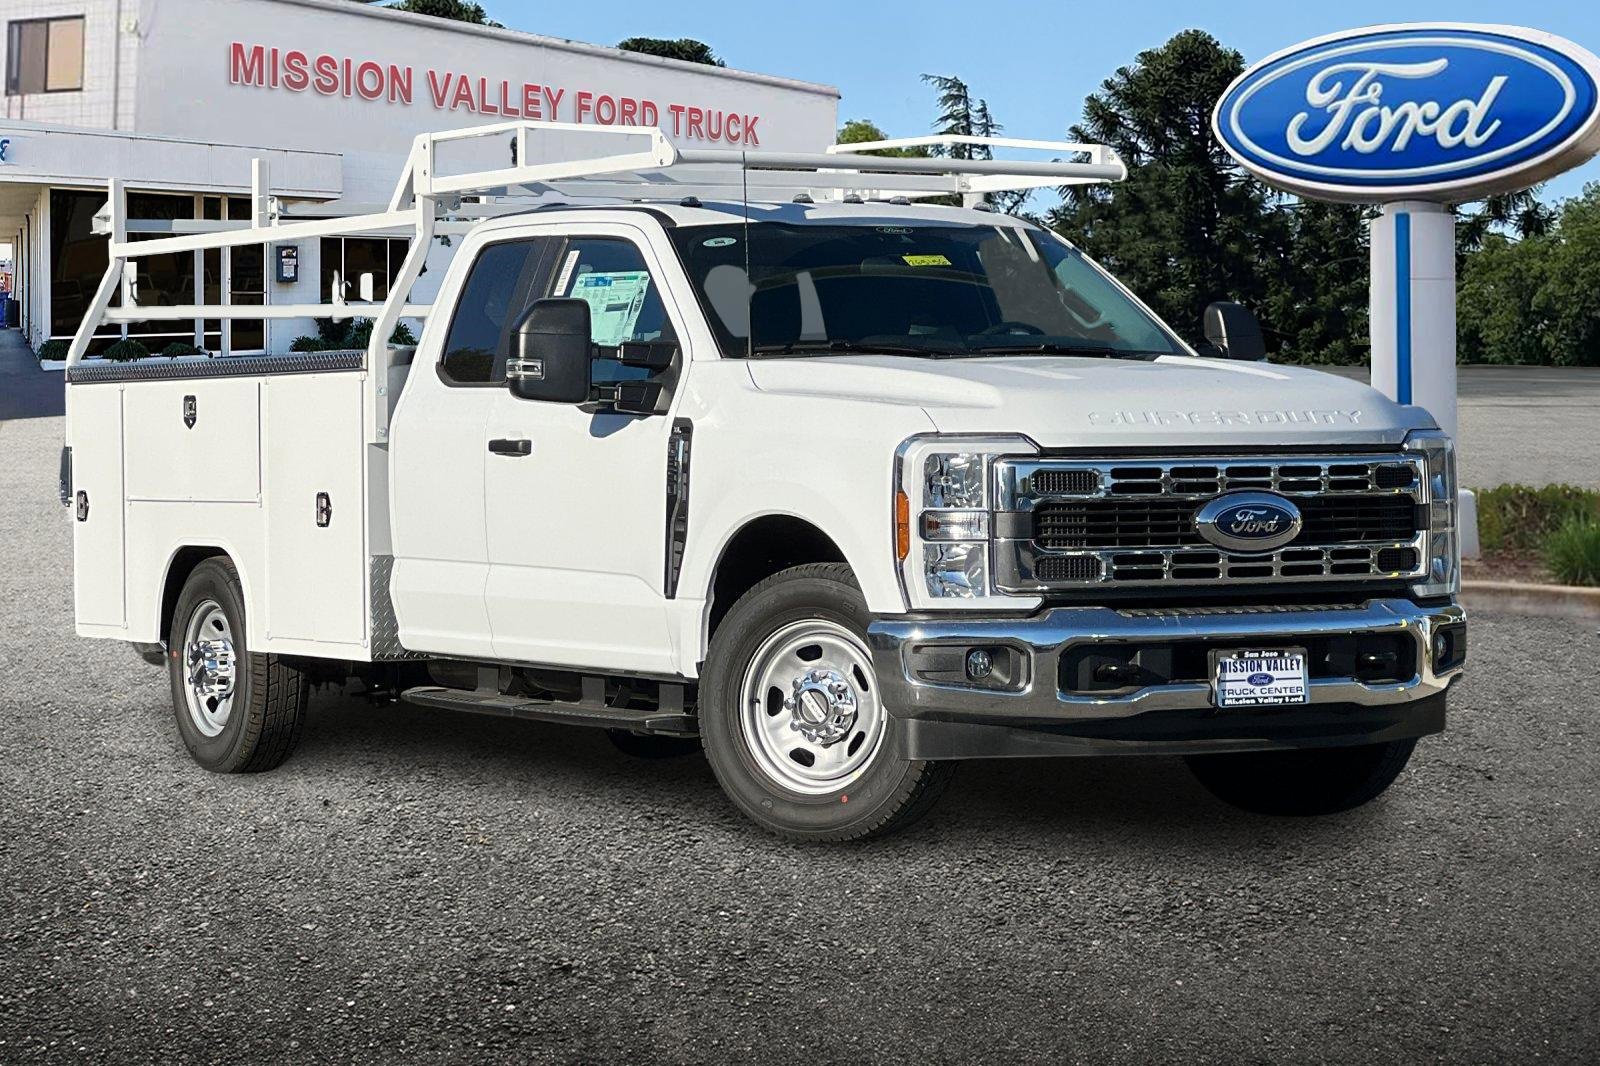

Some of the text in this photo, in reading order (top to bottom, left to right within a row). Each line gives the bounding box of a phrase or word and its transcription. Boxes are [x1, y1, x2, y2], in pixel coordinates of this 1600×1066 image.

[229, 41, 762, 146] MISSION VALLEY FORD TRUCK
[1286, 57, 1509, 157] Ford
[1230, 508, 1280, 533] Ford
[1220, 659, 1301, 673] MISSION VALLEY
[1251, 675, 1271, 684] Ford
[1221, 687, 1303, 696] TRUCK CENTER
[1224, 698, 1256, 706] Mission
